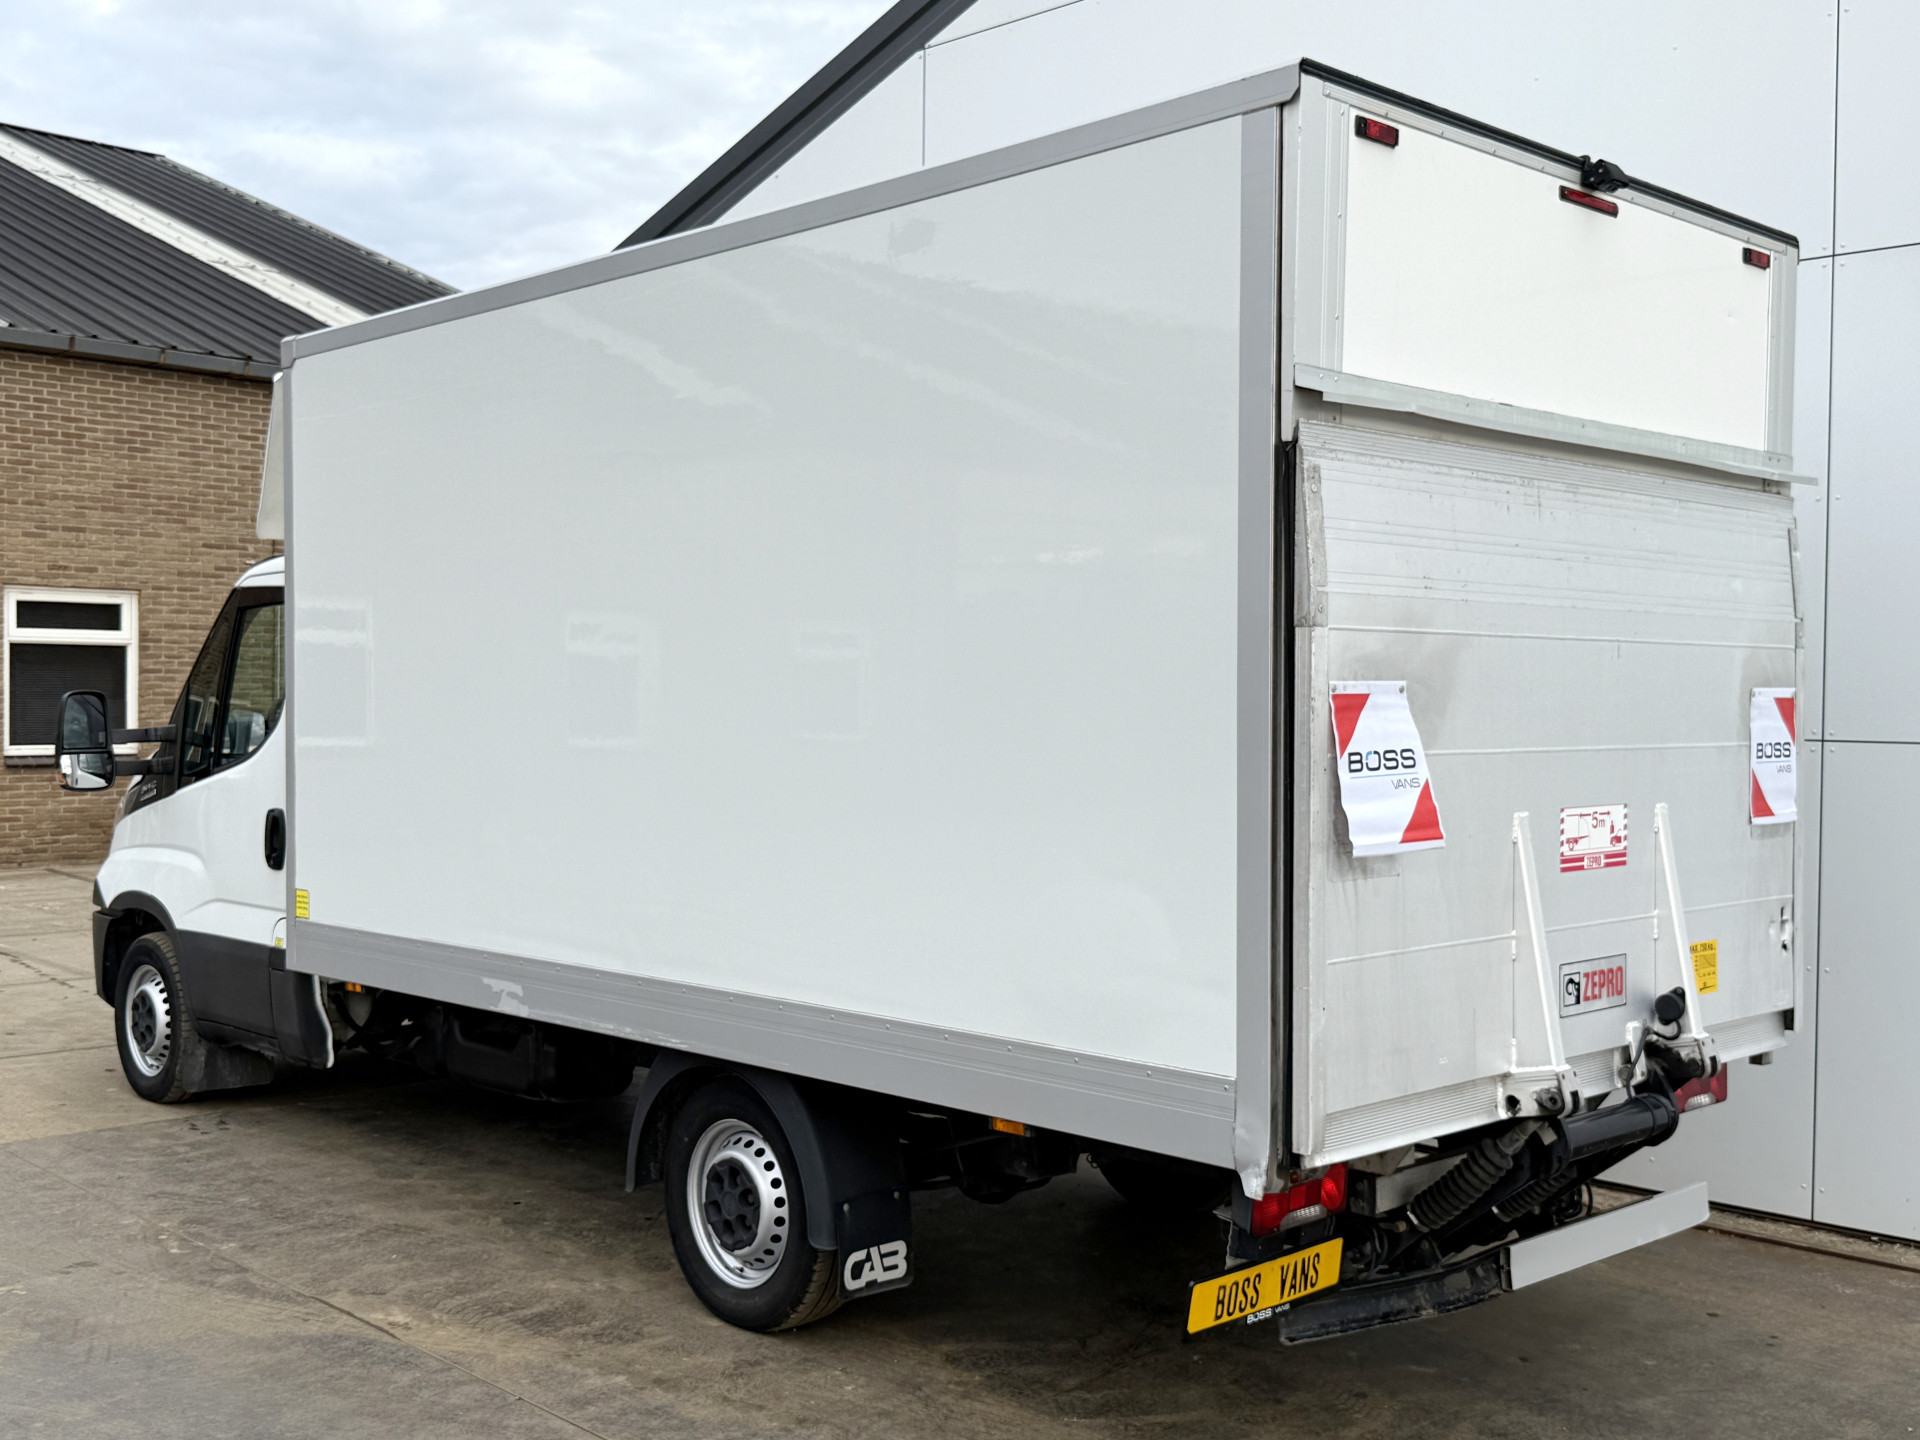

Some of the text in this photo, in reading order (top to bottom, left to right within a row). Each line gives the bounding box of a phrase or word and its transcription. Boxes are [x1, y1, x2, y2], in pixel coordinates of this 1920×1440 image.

[1347, 748, 1417, 773] BOSS
[1756, 742, 1791, 759] BOSS
[1776, 764, 1792, 774] VANS
[1391, 777, 1421, 790] VANS
[1586, 856, 1602, 869] ZEPRO
[1582, 965, 1624, 1002] ZEPRO
[843, 1240, 908, 1291] CAB
[1214, 1252, 1320, 1322] BOSS VANS
[1246, 1303, 1291, 1325] BOSS VANS
